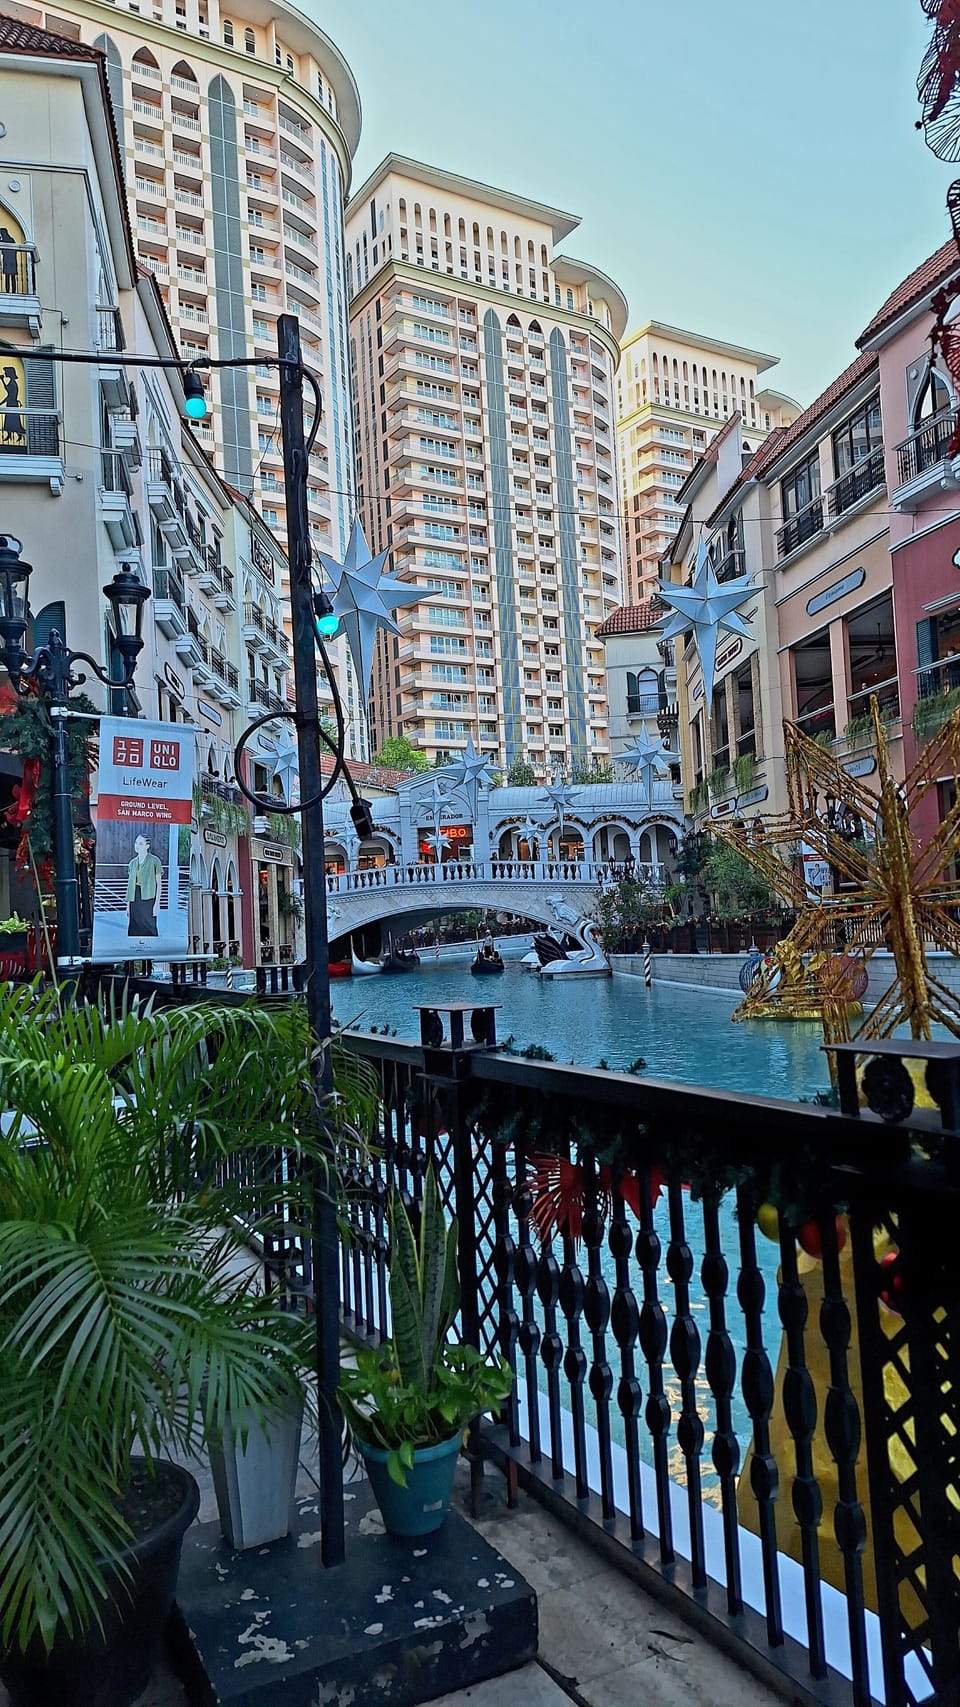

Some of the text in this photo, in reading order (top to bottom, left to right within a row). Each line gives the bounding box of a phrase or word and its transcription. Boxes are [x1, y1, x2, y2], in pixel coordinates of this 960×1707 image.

[153, 743, 175, 755] UNI
[153, 755, 176, 767] QLO
[122, 775, 168, 788] LifeWear
[120, 800, 169, 811] GROUND LEVEL,
[117, 808, 172, 819] SAN MARCO WING
